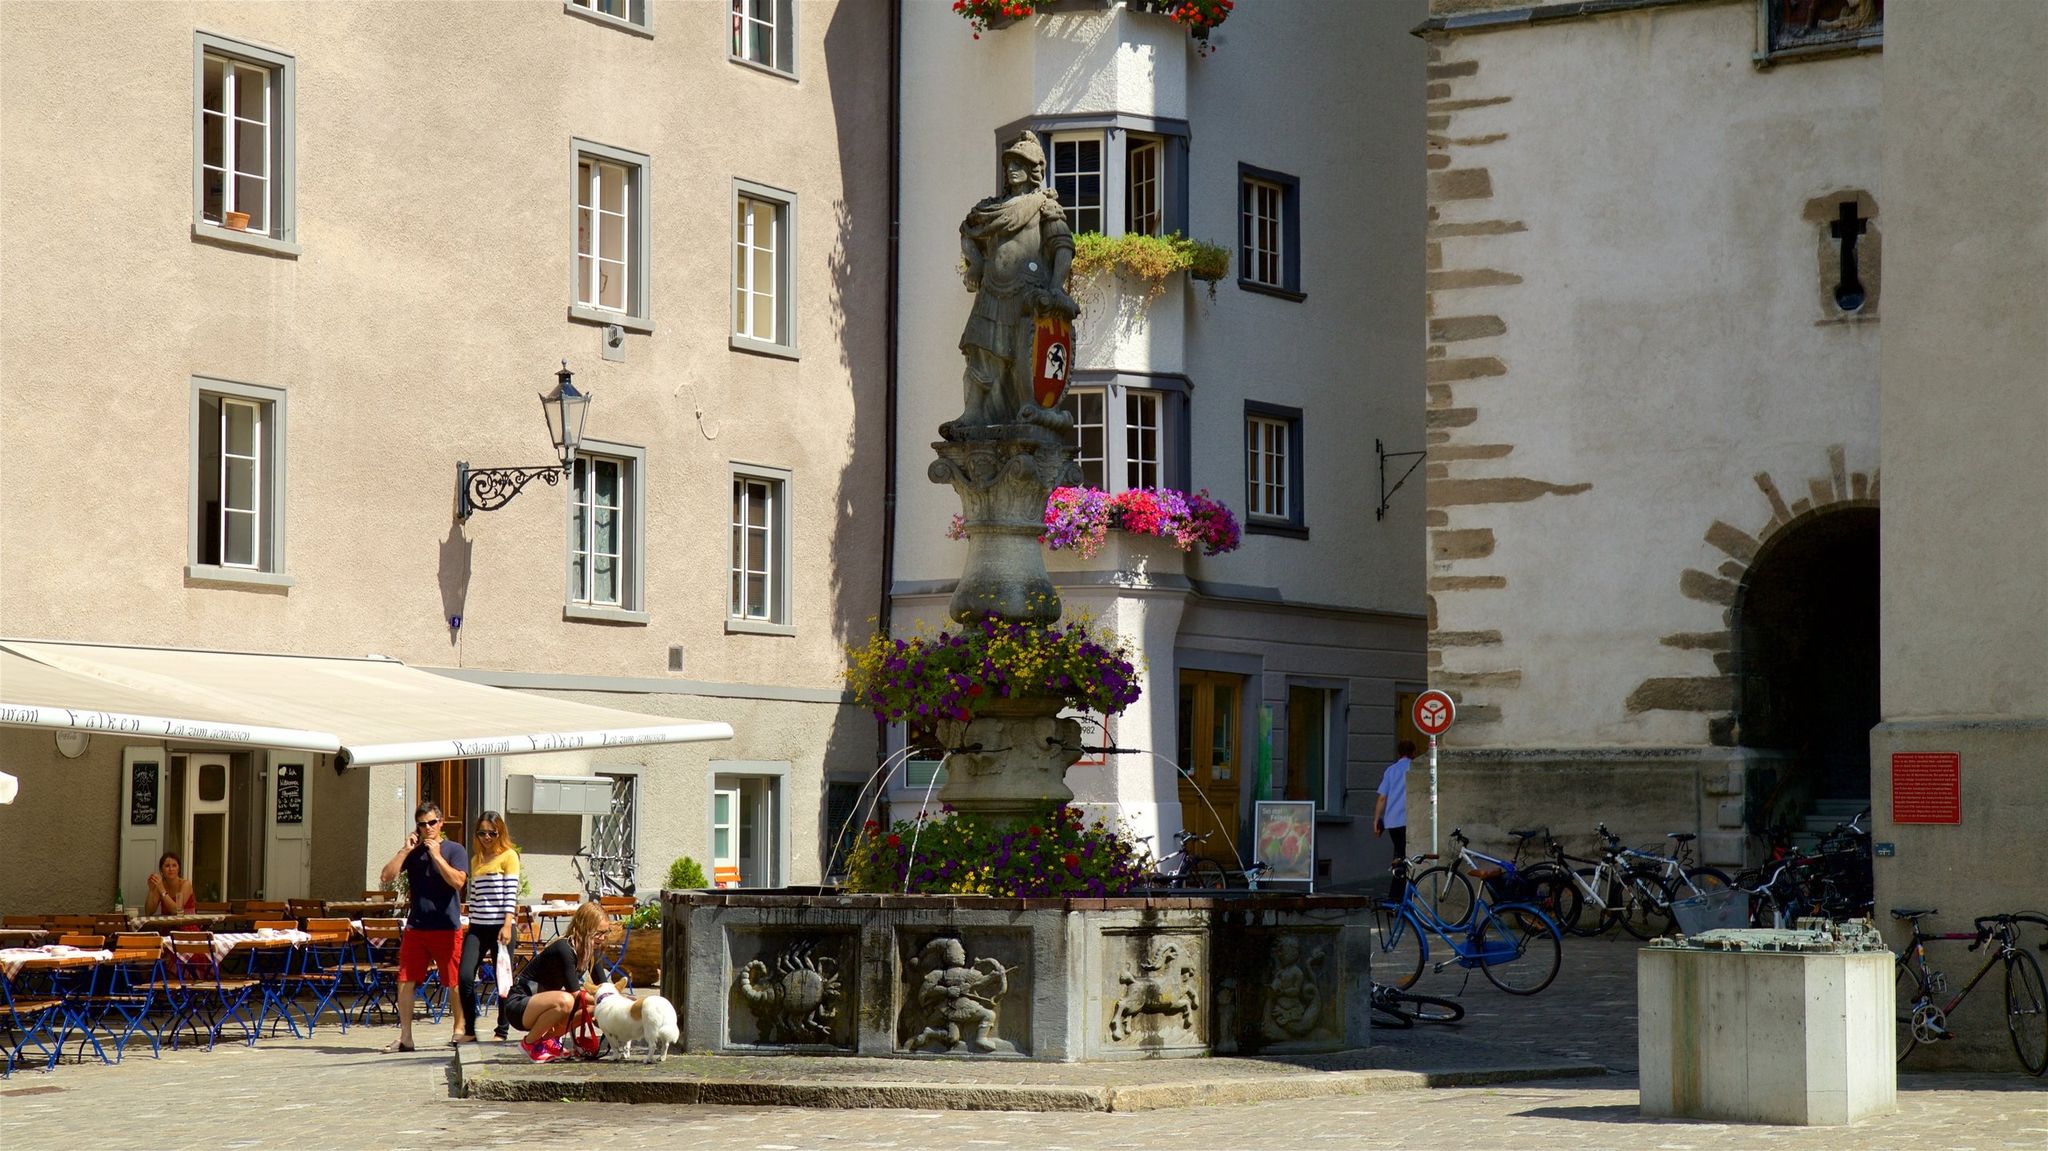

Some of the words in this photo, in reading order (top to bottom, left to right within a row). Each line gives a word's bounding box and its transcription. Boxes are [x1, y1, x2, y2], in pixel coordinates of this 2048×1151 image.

[66, 709, 140, 731] Falken
[188, 727, 208, 738] zum
[1080, 726, 1095, 735] 982
[452, 740, 510, 756] Restaurant
[528, 733, 584, 751] Falken
